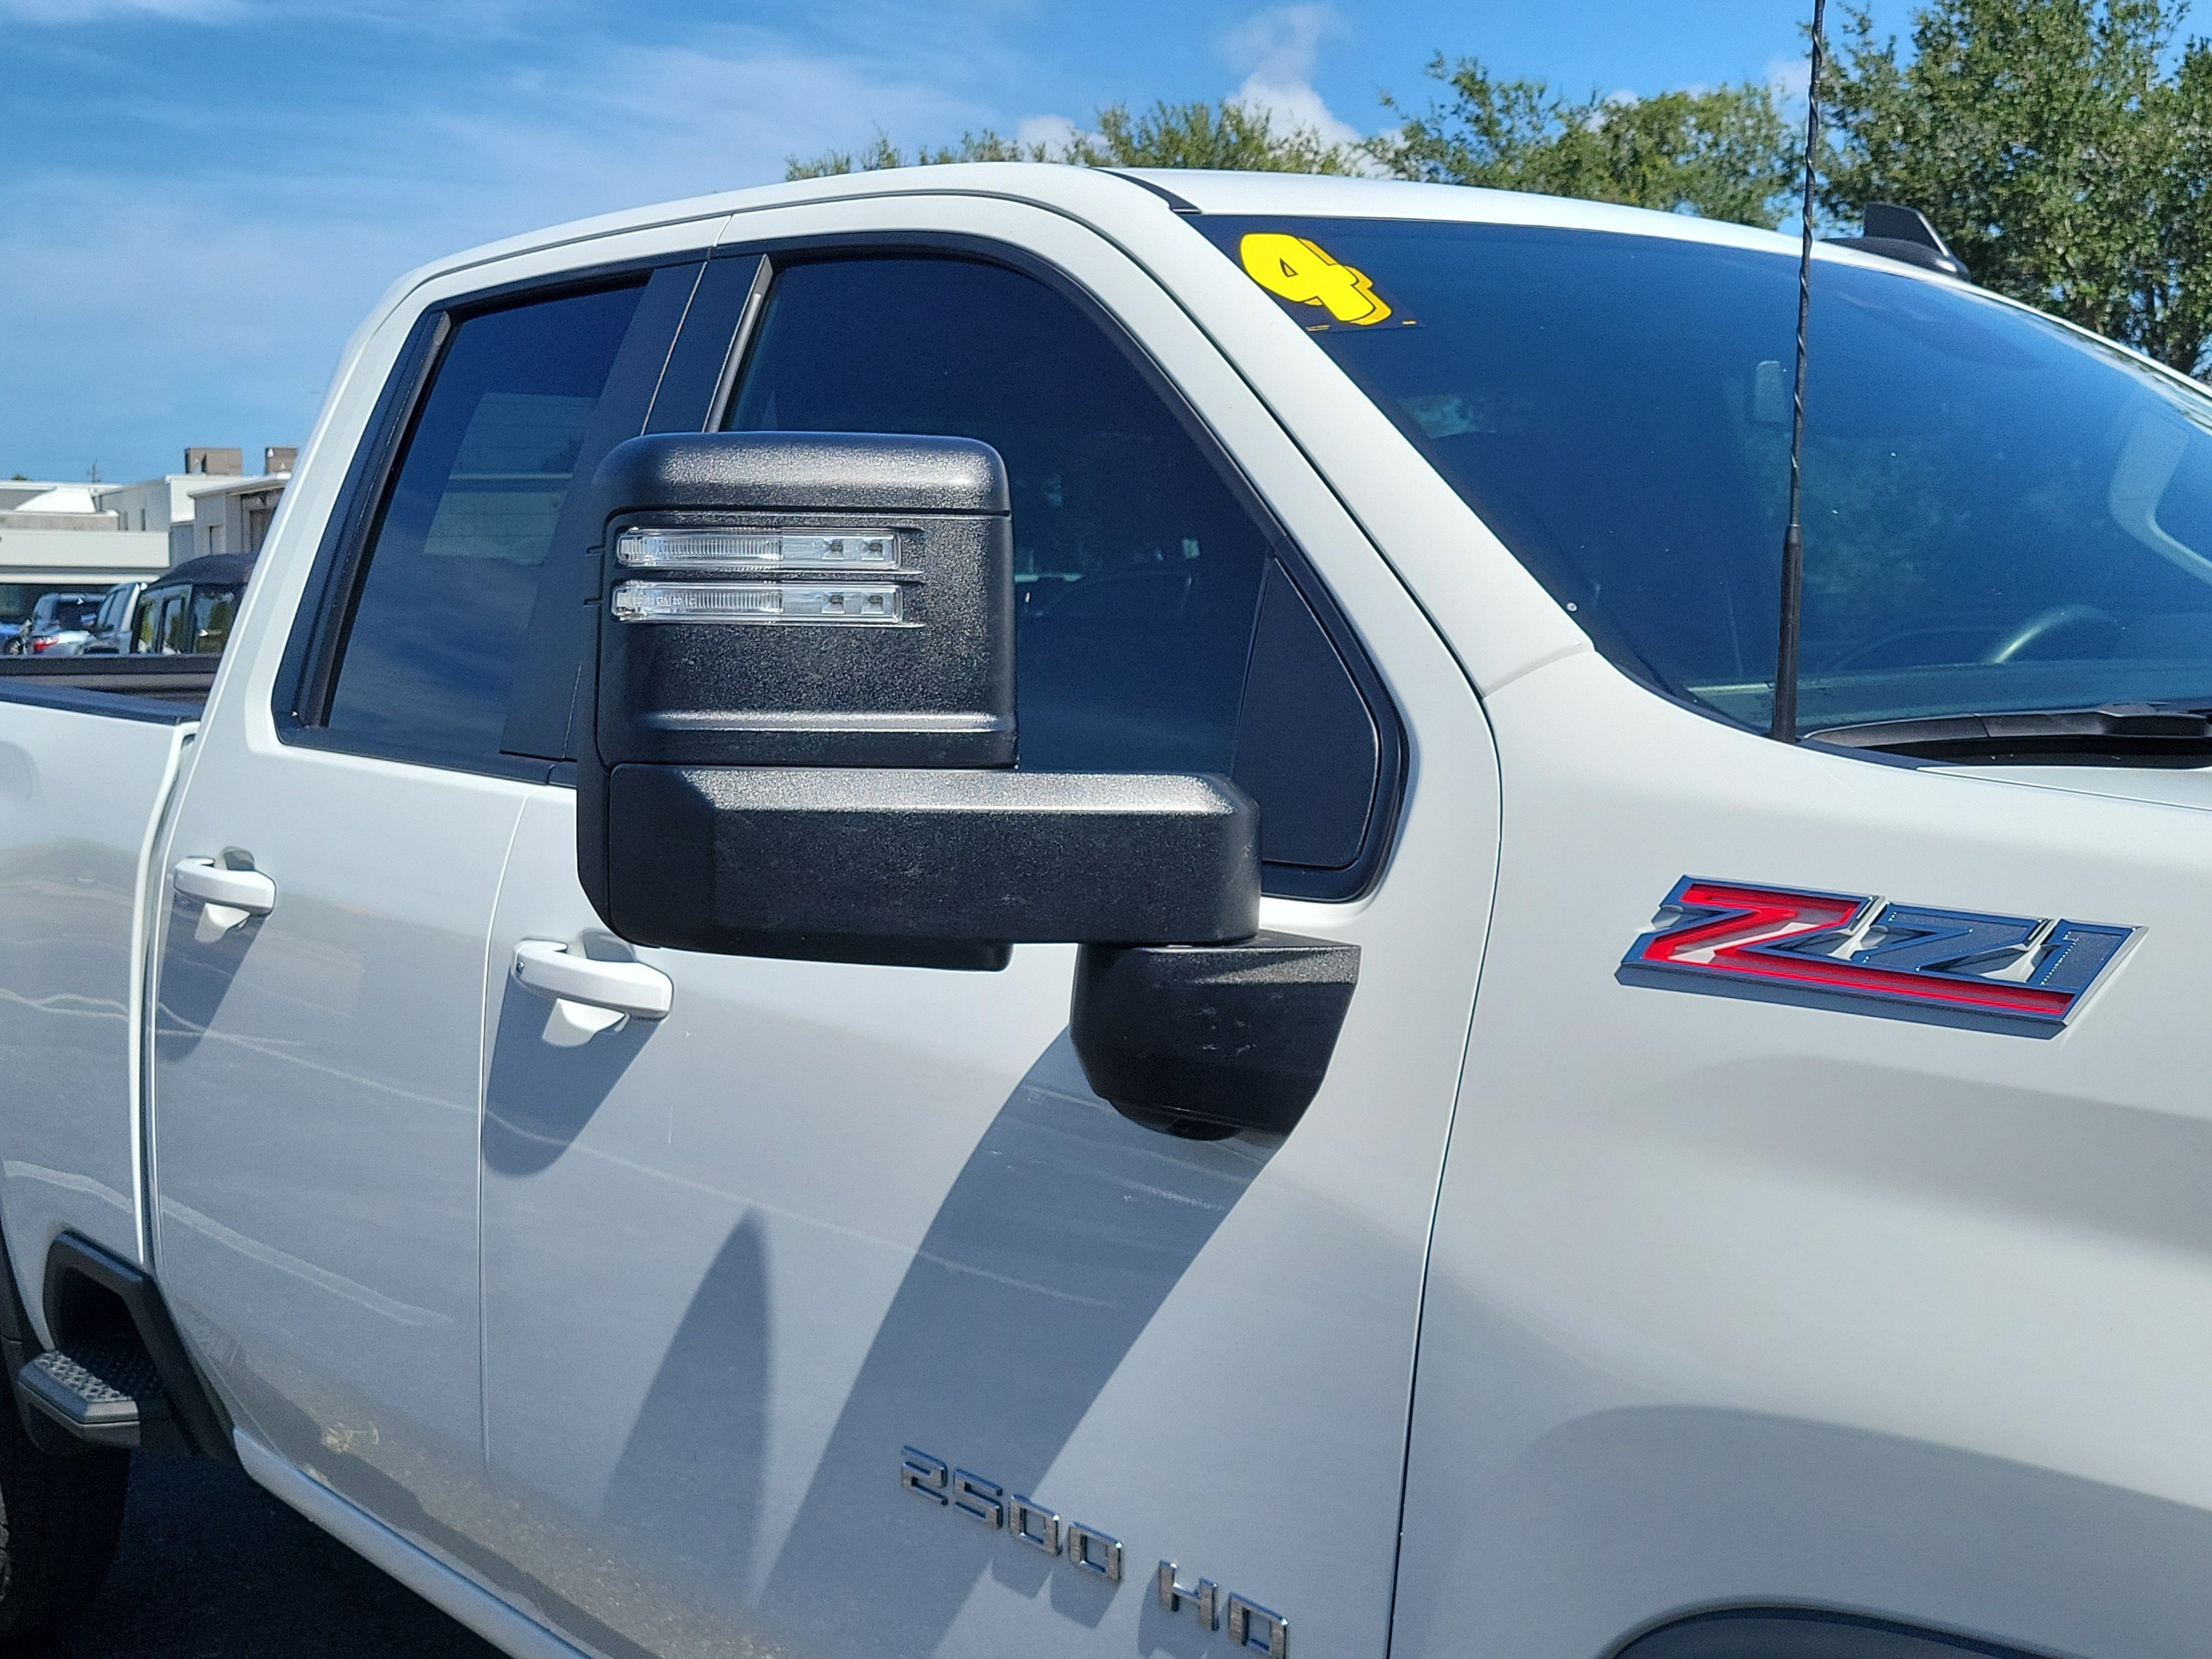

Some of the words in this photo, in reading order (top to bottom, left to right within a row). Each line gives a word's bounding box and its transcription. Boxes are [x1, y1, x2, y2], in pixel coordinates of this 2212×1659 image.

[1240, 233, 1392, 325] 4
[1615, 874, 2149, 1040] Z71
[901, 1445, 1123, 1583] 2500
[1157, 1559, 1289, 1658] HD
